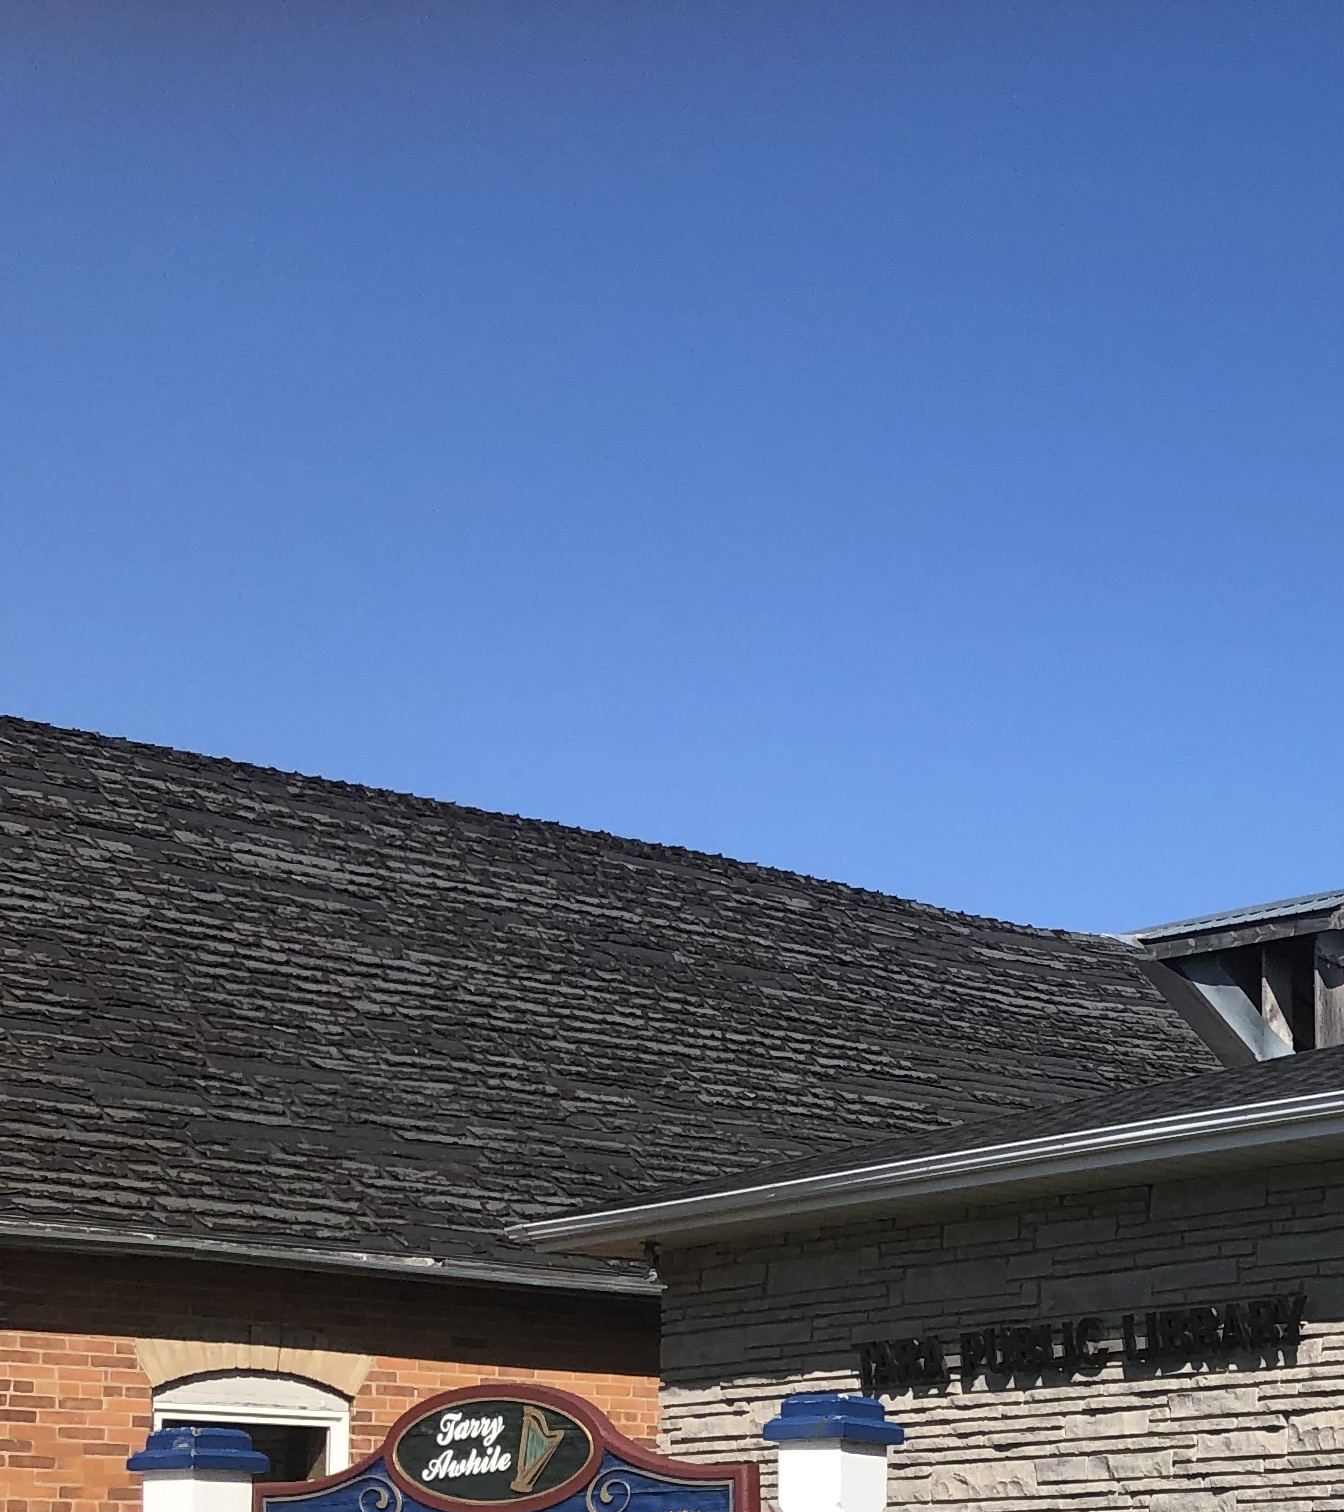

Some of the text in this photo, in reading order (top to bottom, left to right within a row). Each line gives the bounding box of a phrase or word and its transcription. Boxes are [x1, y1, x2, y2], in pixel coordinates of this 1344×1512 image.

[961, 1316, 1108, 1376] PUBLIC
[1123, 1295, 1307, 1362] LIBRARY
[436, 1411, 505, 1447] Tarry
[421, 1445, 512, 1482] Awhile
